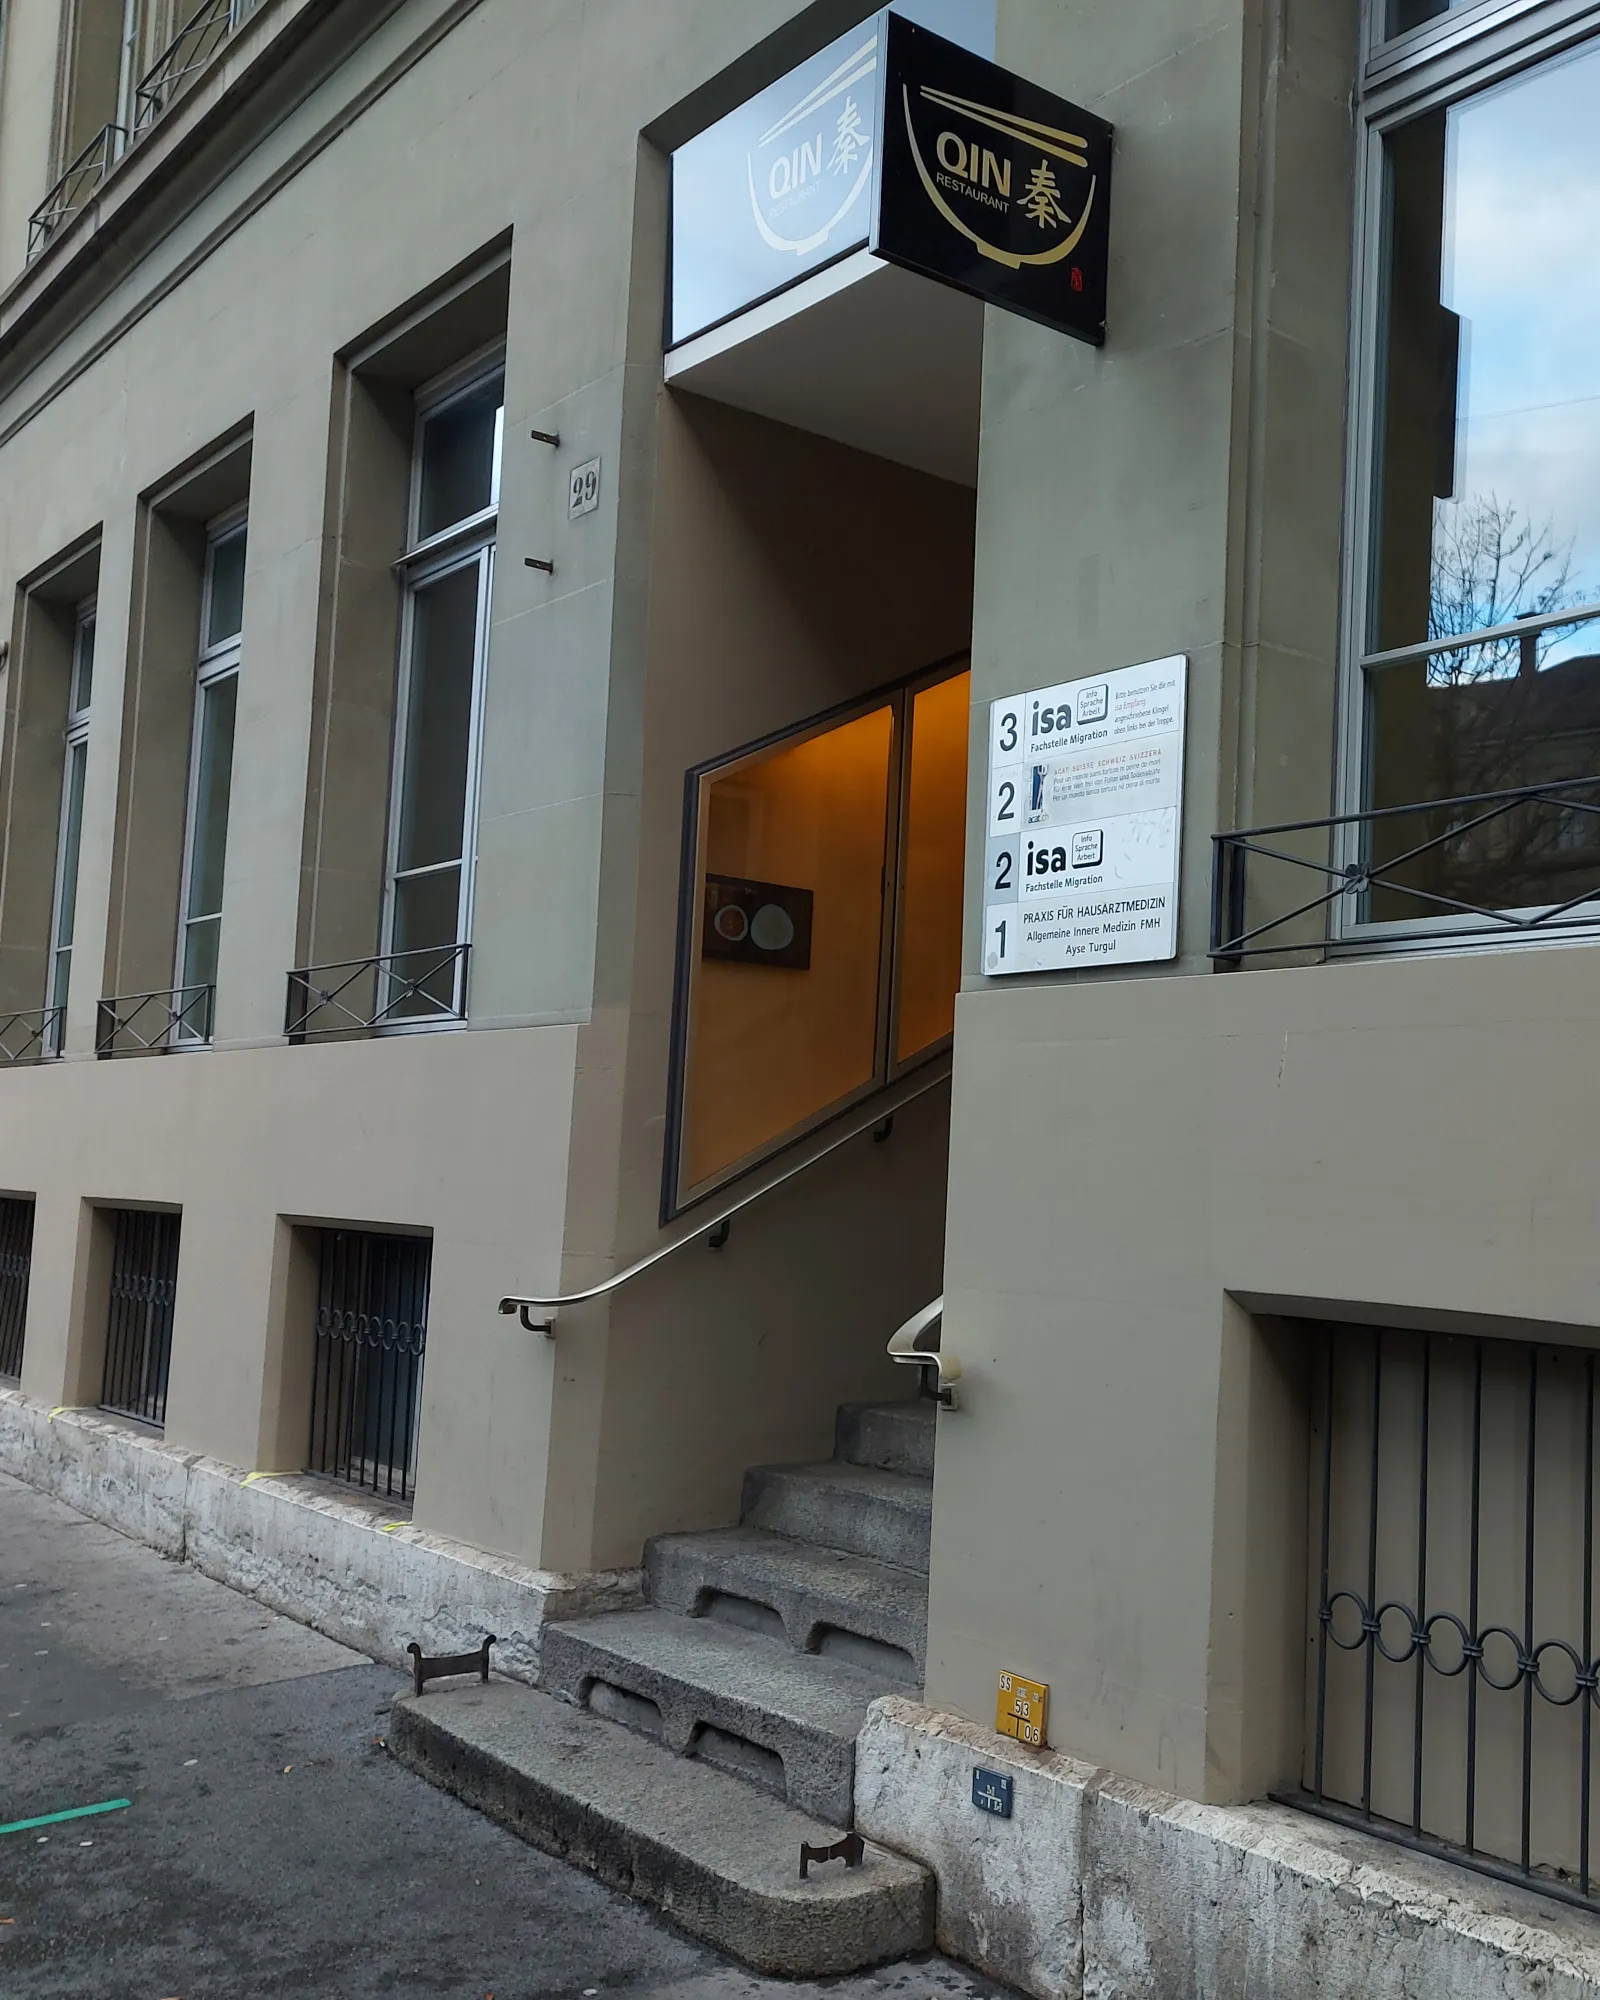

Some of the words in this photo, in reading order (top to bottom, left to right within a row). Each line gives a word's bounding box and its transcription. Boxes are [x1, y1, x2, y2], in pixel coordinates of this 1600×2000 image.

[826, 95, 871, 177] 秦
[769, 133, 822, 198] QIN
[936, 131, 1011, 198] QIN
[936, 172, 1010, 215] RESTAURANT
[1016, 159, 1072, 229] 秦
[571, 471, 597, 509] 29
[1085, 690, 1098, 699] Info
[1150, 683, 1158, 692] Sie
[1158, 681, 1167, 690] die
[1166, 680, 1176, 688] mit
[1079, 697, 1104, 710] Sprache
[1081, 707, 1101, 718] Arbeit
[1114, 709, 1151, 723] angeschriebene
[1151, 703, 1170, 714] Klingel
[1123, 699, 1146, 710] Empfang
[1031, 700, 1072, 736] isa
[1114, 726, 1126, 735] oben
[1147, 719, 1156, 728] der
[999, 712, 1018, 752] 3
[1030, 737, 1068, 753] Fachstelle
[1069, 729, 1108, 745] Migration
[1053, 766, 1069, 776] ACAT
[1072, 762, 1094, 772] SUISSE
[1097, 755, 1127, 767] SCHWEIZ
[1129, 748, 1162, 761] SVIZZERA
[997, 781, 1015, 821] 2
[1074, 842, 1098, 853] Sprache
[1080, 834, 1093, 843] Info
[1026, 840, 1067, 876] isa
[1076, 852, 1096, 862] Arbeit
[994, 851, 1012, 890] 2
[1025, 879, 1063, 893] Fachstelle
[1064, 873, 1103, 888] Migration
[1023, 910, 1055, 924] PRAXIS
[1057, 905, 1074, 920] FÜR
[1077, 896, 1166, 918] HAUSARZTMEDIZIN
[994, 920, 1006, 959] 1
[1026, 929, 1071, 943] Allgemeine
[1073, 926, 1100, 938] Innere
[1102, 920, 1136, 934] Medizin
[1140, 918, 1161, 930] FMH
[1065, 944, 1086, 956] Ayse
[1088, 939, 1117, 954] Turgul
[1000, 1675, 1011, 1691] SS
